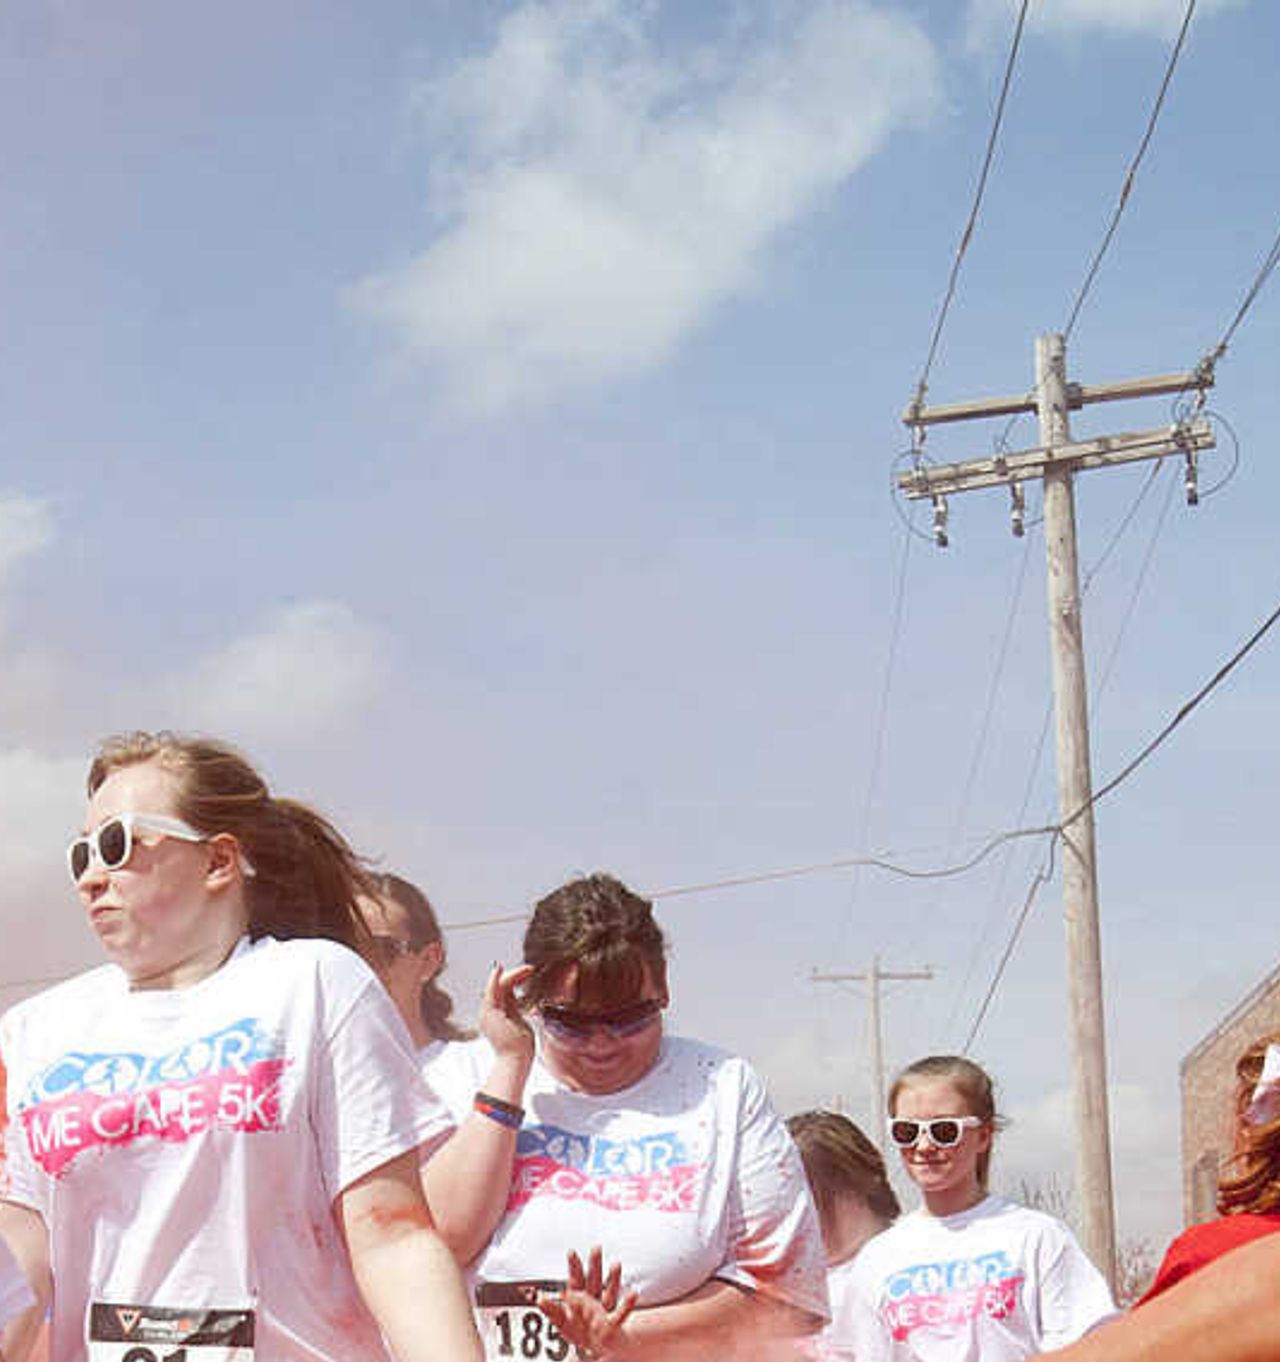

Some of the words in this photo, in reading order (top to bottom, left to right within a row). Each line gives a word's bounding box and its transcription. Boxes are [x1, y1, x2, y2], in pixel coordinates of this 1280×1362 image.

[32, 1030, 251, 1099] COLOR
[30, 1105, 81, 1155] ME
[217, 1082, 276, 1127] 5K
